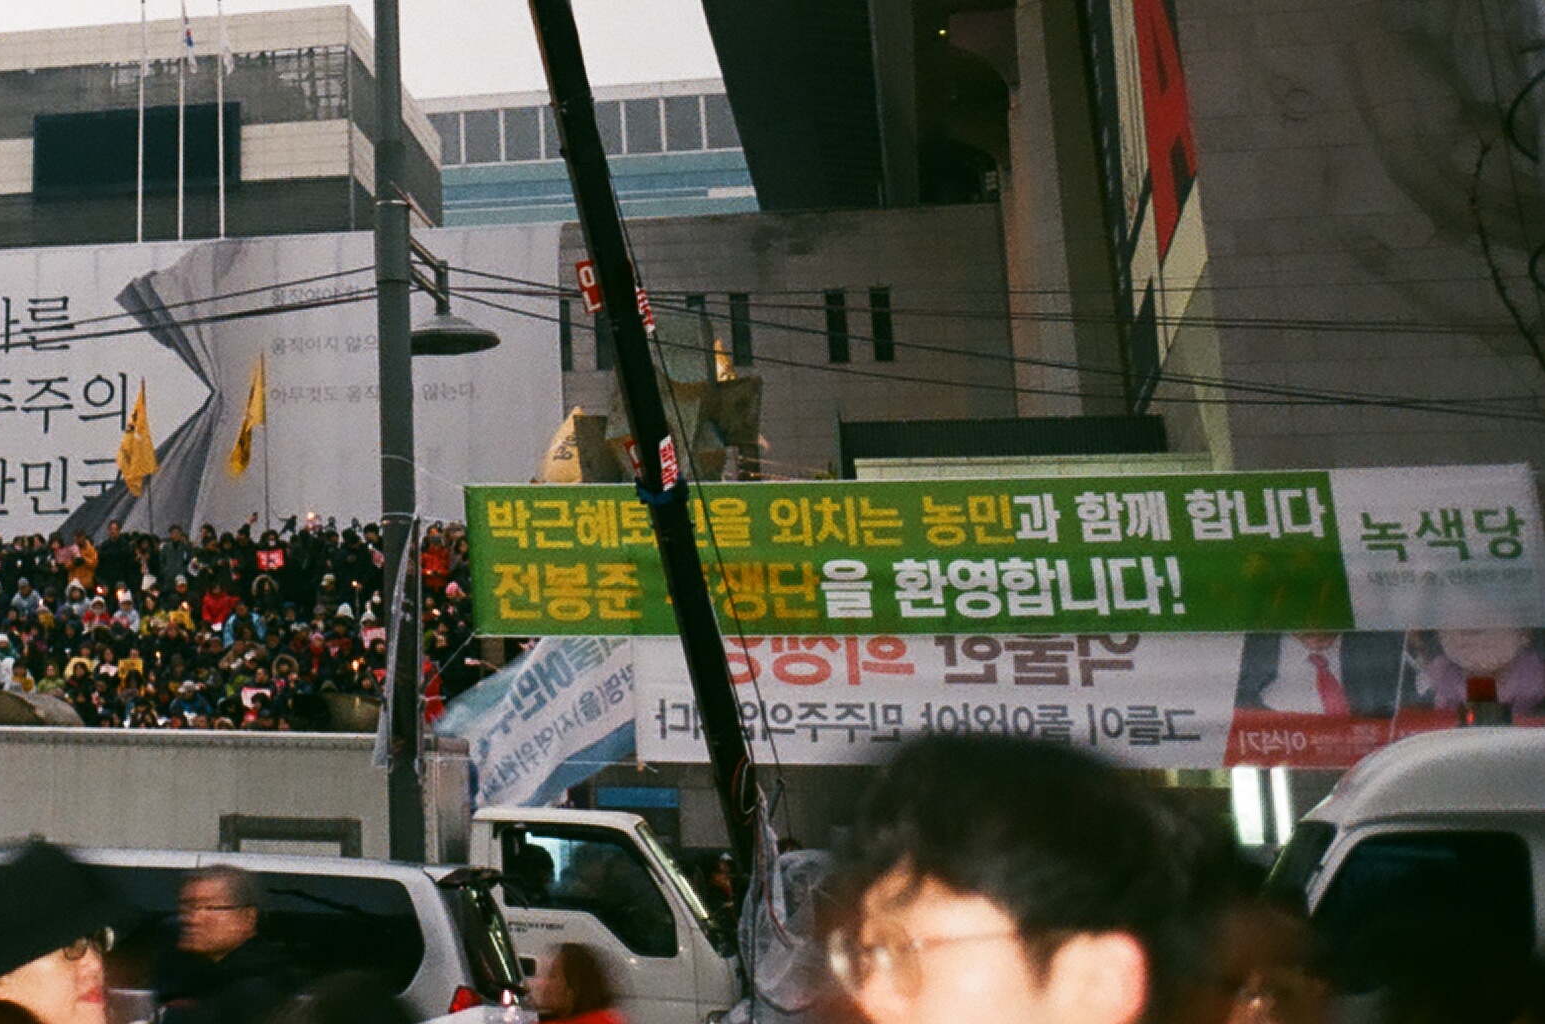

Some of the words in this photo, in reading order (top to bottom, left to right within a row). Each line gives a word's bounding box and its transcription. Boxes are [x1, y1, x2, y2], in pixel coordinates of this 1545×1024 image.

[768, 494, 904, 547] 외치는
[921, 492, 1061, 547] 농민과
[1074, 491, 1172, 544] 함께
[1185, 485, 1326, 542] 합니다
[1360, 505, 1526, 562] 녹색당
[492, 562, 643, 622] 전봉준
[665, 559, 874, 621] 쟁단을
[892, 555, 1186, 618] 환영합니다!
